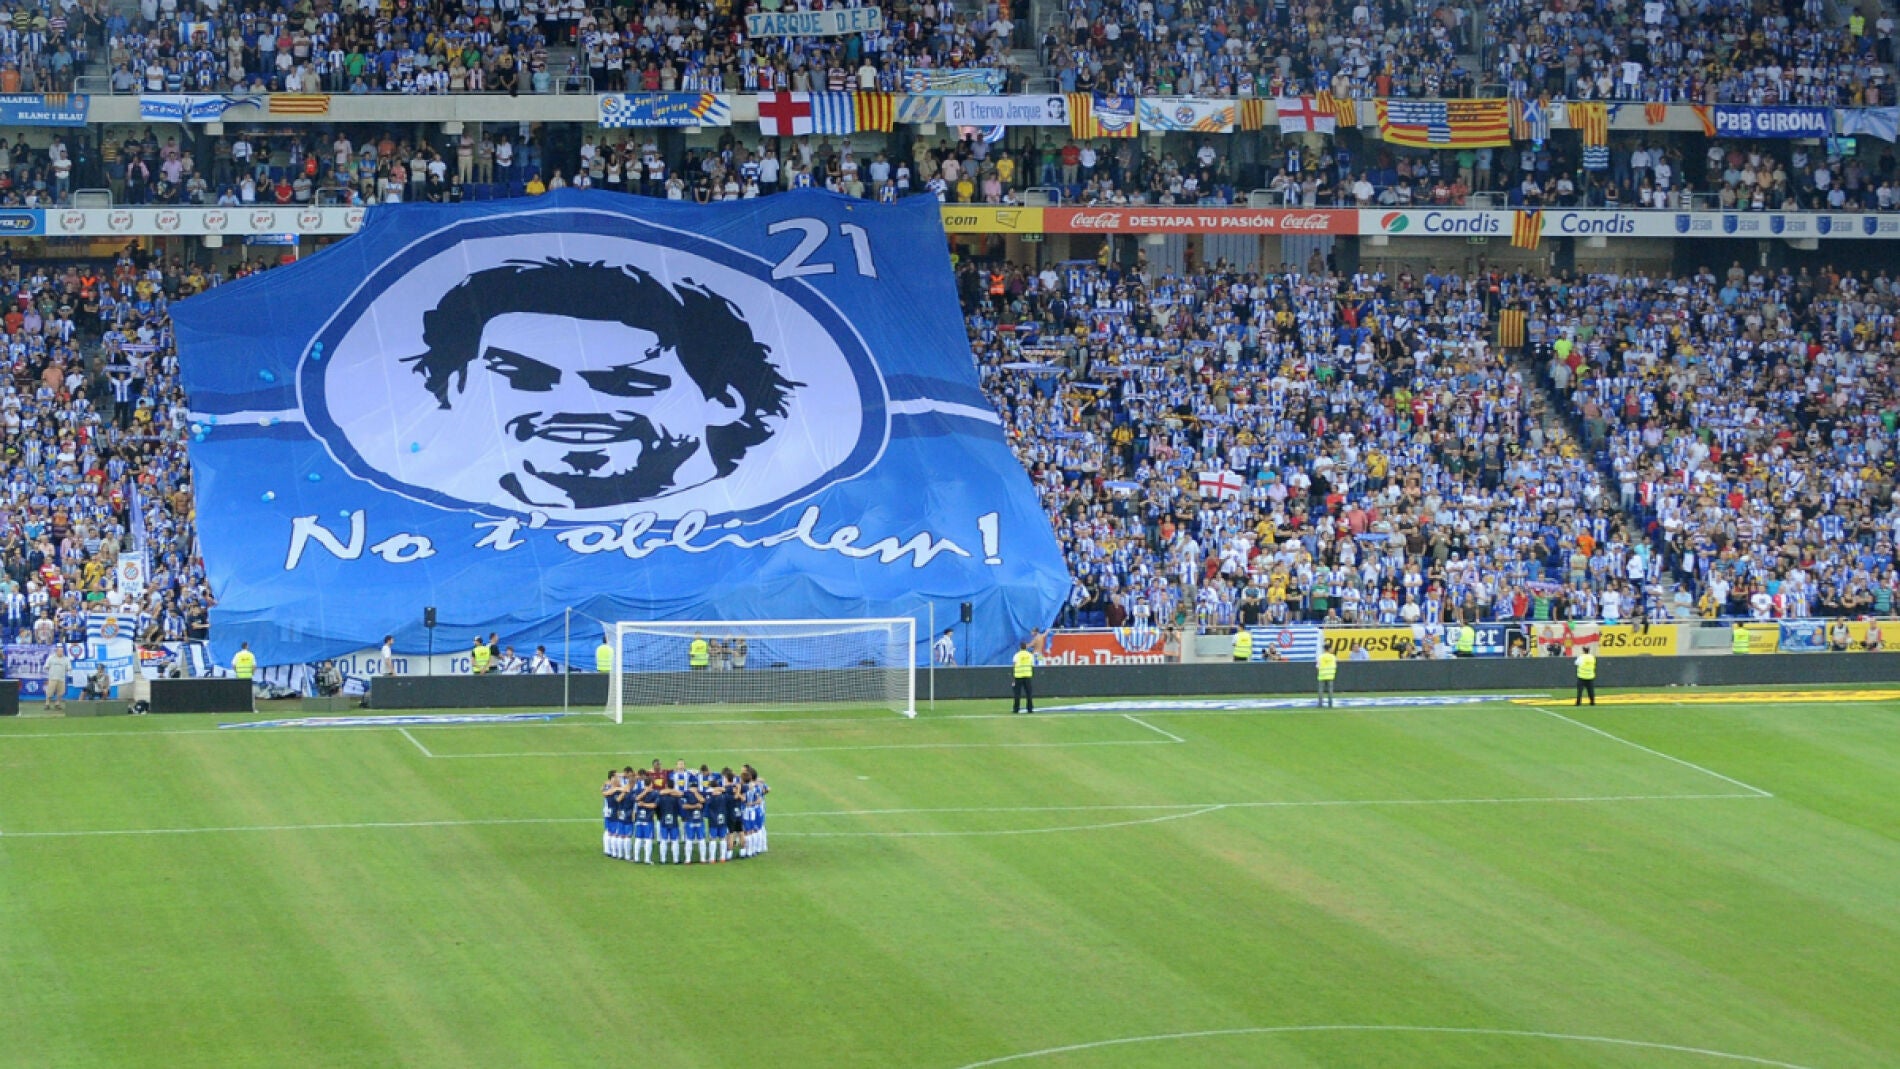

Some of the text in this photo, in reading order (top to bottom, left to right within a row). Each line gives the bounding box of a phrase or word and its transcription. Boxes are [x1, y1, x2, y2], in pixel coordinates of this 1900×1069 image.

[953, 101, 1041, 121] 21 Eterno Jarque
[1717, 112, 1826, 131] PBB GIRONA
[1129, 216, 1194, 227] DESTAPA
[1198, 216, 1217, 227] TU
[1221, 213, 1274, 227] PASIÓN
[1424, 212, 1500, 233] Condis
[1561, 213, 1635, 233] Condis
[768, 217, 878, 280] 21
[284, 509, 437, 570] No
